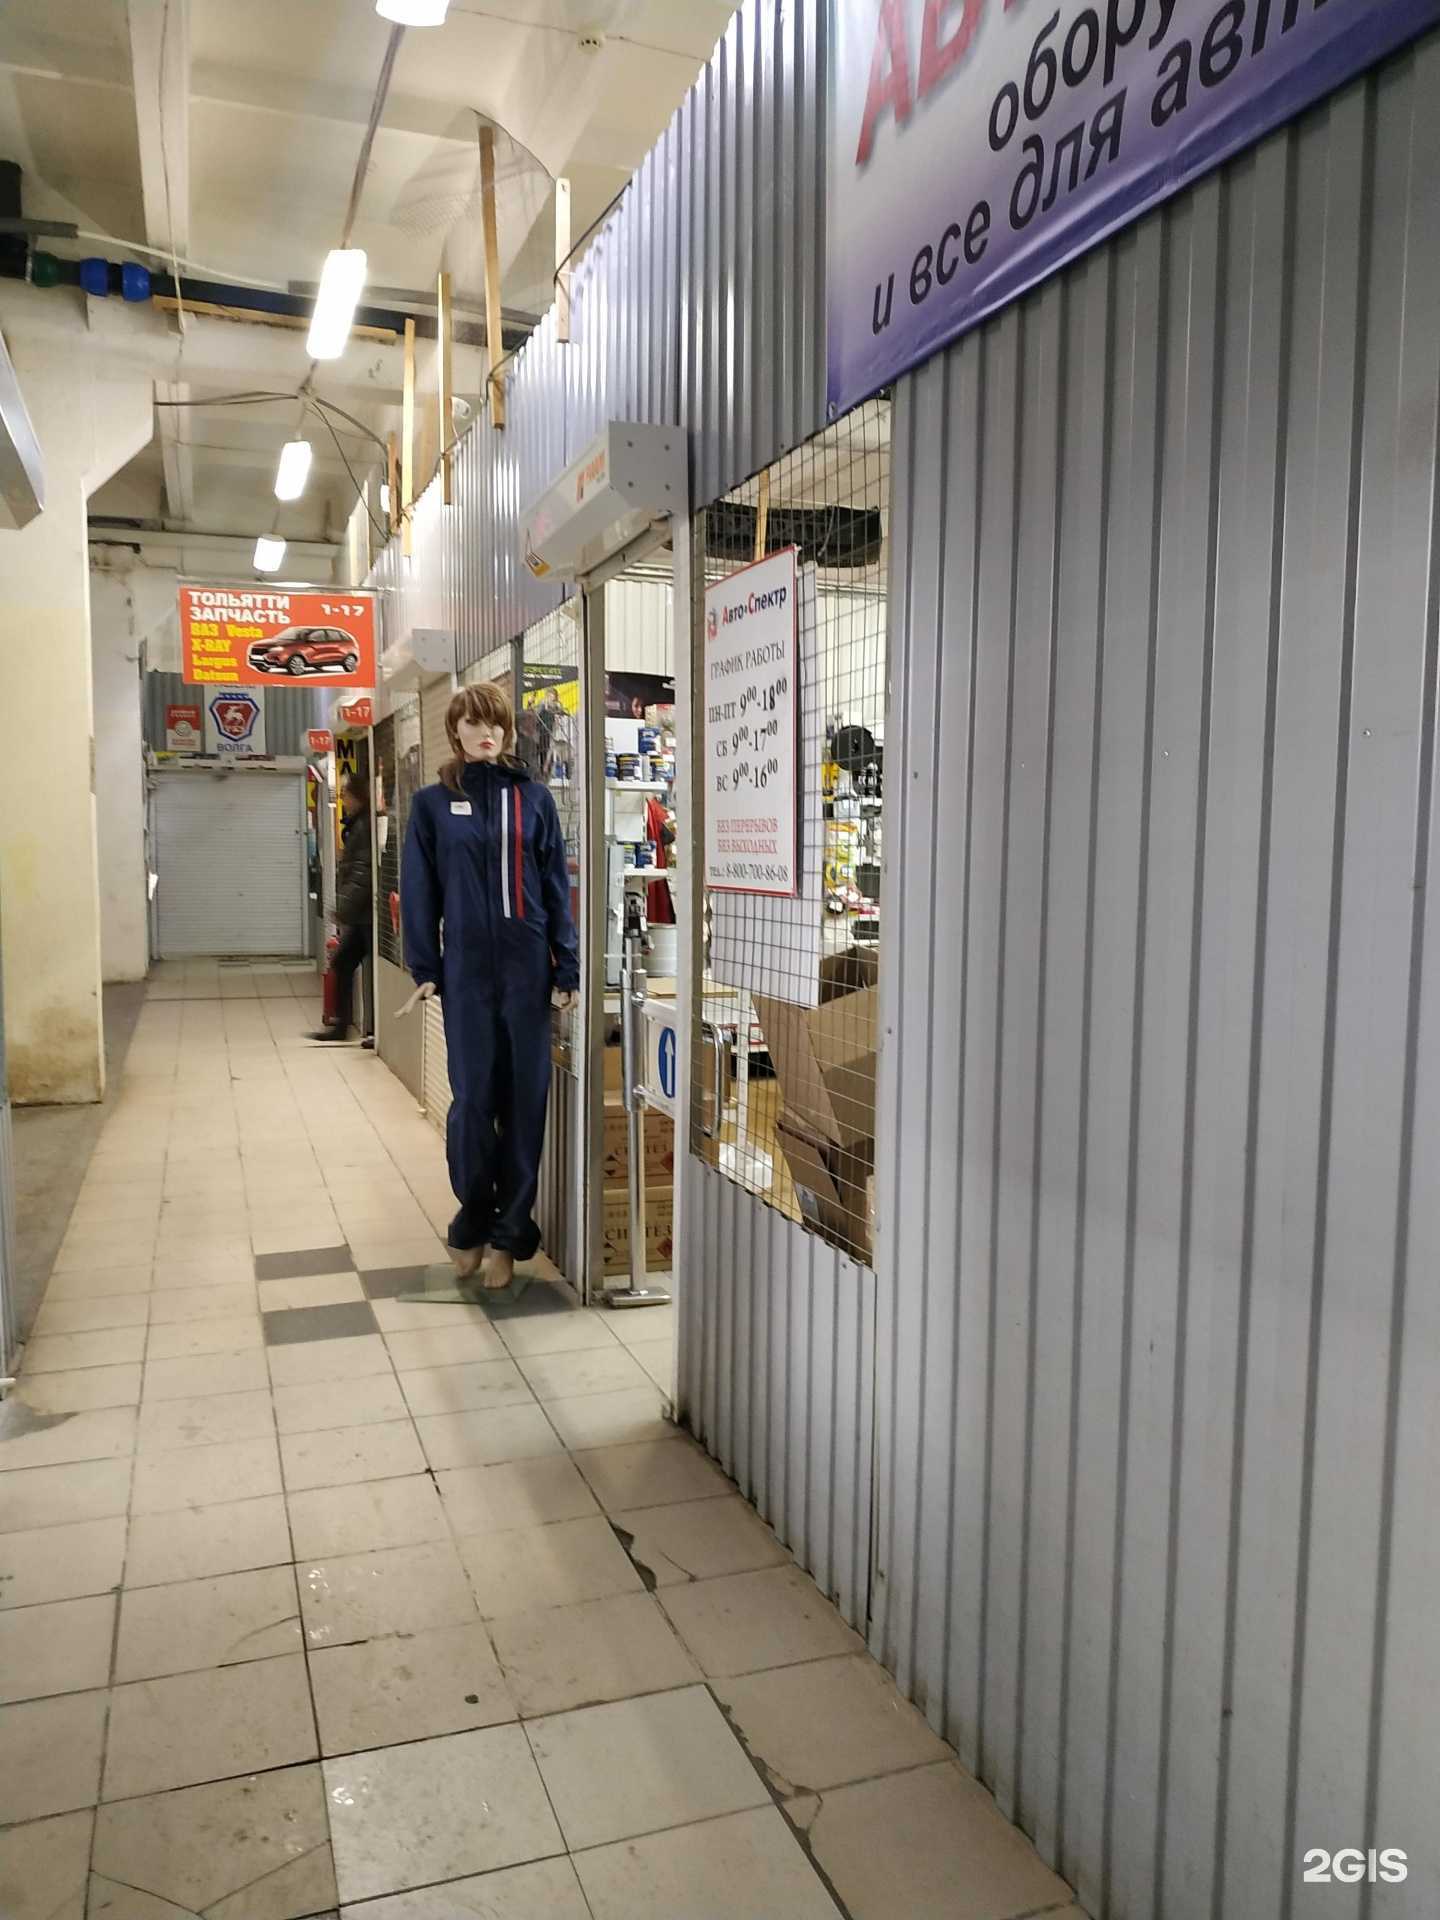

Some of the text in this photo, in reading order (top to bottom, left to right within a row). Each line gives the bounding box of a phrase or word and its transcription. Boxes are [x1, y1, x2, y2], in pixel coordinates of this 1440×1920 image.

[855, 0, 1020, 166] АВ
[872, 273, 894, 336] и
[909, 200, 991, 305] все
[1009, 87, 1127, 231] для
[188, 591, 364, 617] ТОЛЬЯТТИ 1-17
[190, 607, 291, 624] ЗАПЧАСТЬ
[711, 640, 785, 680] ГРАФИК РАБОТЫ
[709, 702, 736, 723] ПН-ПТ
[217, 743, 253, 752] ВОЛГА
[716, 740, 728, 757] СБ
[716, 775, 728, 792] ВС
